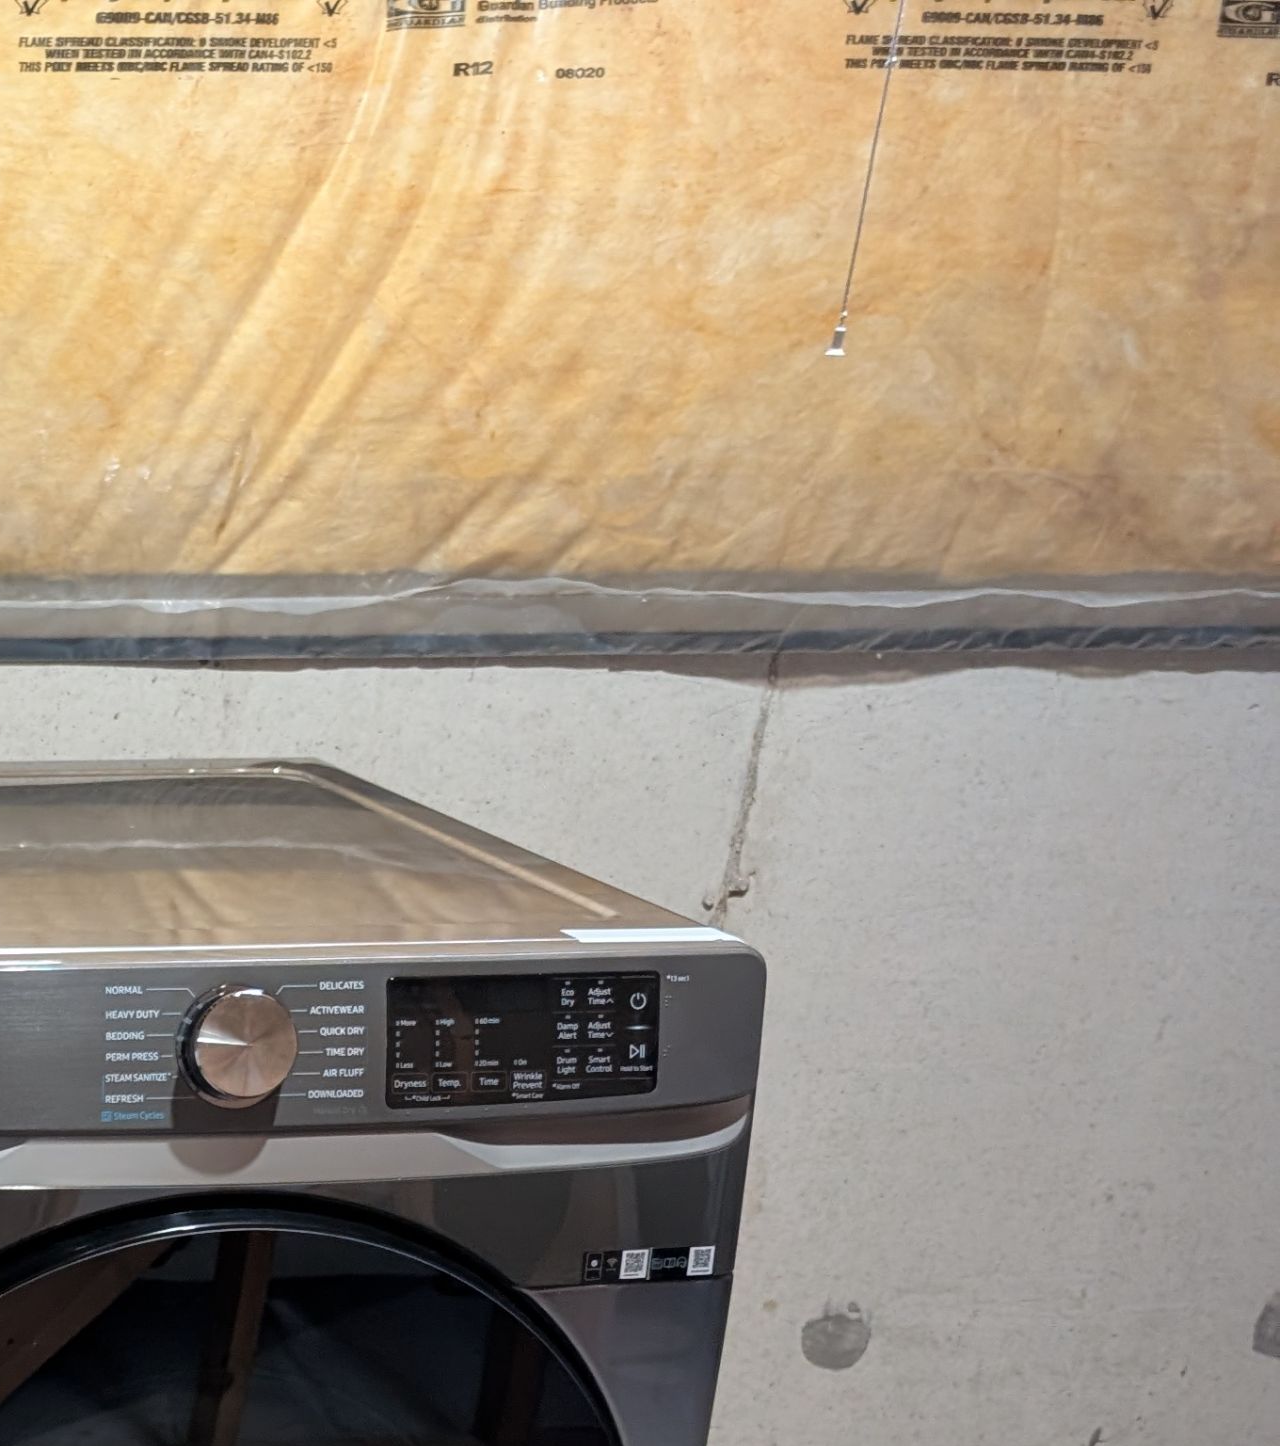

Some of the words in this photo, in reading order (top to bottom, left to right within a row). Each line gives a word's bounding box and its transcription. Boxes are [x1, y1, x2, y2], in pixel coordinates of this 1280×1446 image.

[18, 37, 53, 47] FLAME
[19, 61, 42, 72] THIS
[453, 61, 494, 77] R12
[555, 67, 605, 79] 08020
[319, 981, 365, 990] DELICATES
[104, 986, 143, 995] NORMAL
[587, 988, 611, 997] Adjust
[561, 998, 575, 1007] Dry
[105, 1010, 135, 1019] HEAVY
[136, 1010, 160, 1019] DUTY
[309, 1006, 365, 1015] ACTIVEWEAR
[320, 1027, 346, 1036] QUICK
[347, 1026, 365, 1035] DRY
[557, 1022, 579, 1031] Damp
[587, 1022, 611, 1031] Adjust
[105, 1031, 145, 1041] BEDDING
[558, 1031, 577, 1039] Alert
[325, 1048, 346, 1056] TIME
[347, 1047, 365, 1056] DRY
[105, 1053, 130, 1062] PERM
[131, 1052, 159, 1061] PRESS
[557, 1056, 577, 1064] Drum
[588, 1055, 611, 1064] Smart
[323, 1069, 338, 1077] AIR
[339, 1068, 365, 1077] FLUFF
[557, 1065, 576, 1074] Light
[586, 1064, 613, 1073] Control
[104, 1074, 132, 1082] STEAM
[513, 1072, 543, 1080] Wrinkle
[394, 1080, 427, 1089] Dryness
[438, 1078, 462, 1088] Temp.
[479, 1077, 499, 1086] Time
[512, 1081, 543, 1090] Prevent
[307, 1090, 364, 1098] DOWNLOADED
[104, 1094, 144, 1104] REFRESH
[139, 1111, 165, 1121] Cycles
